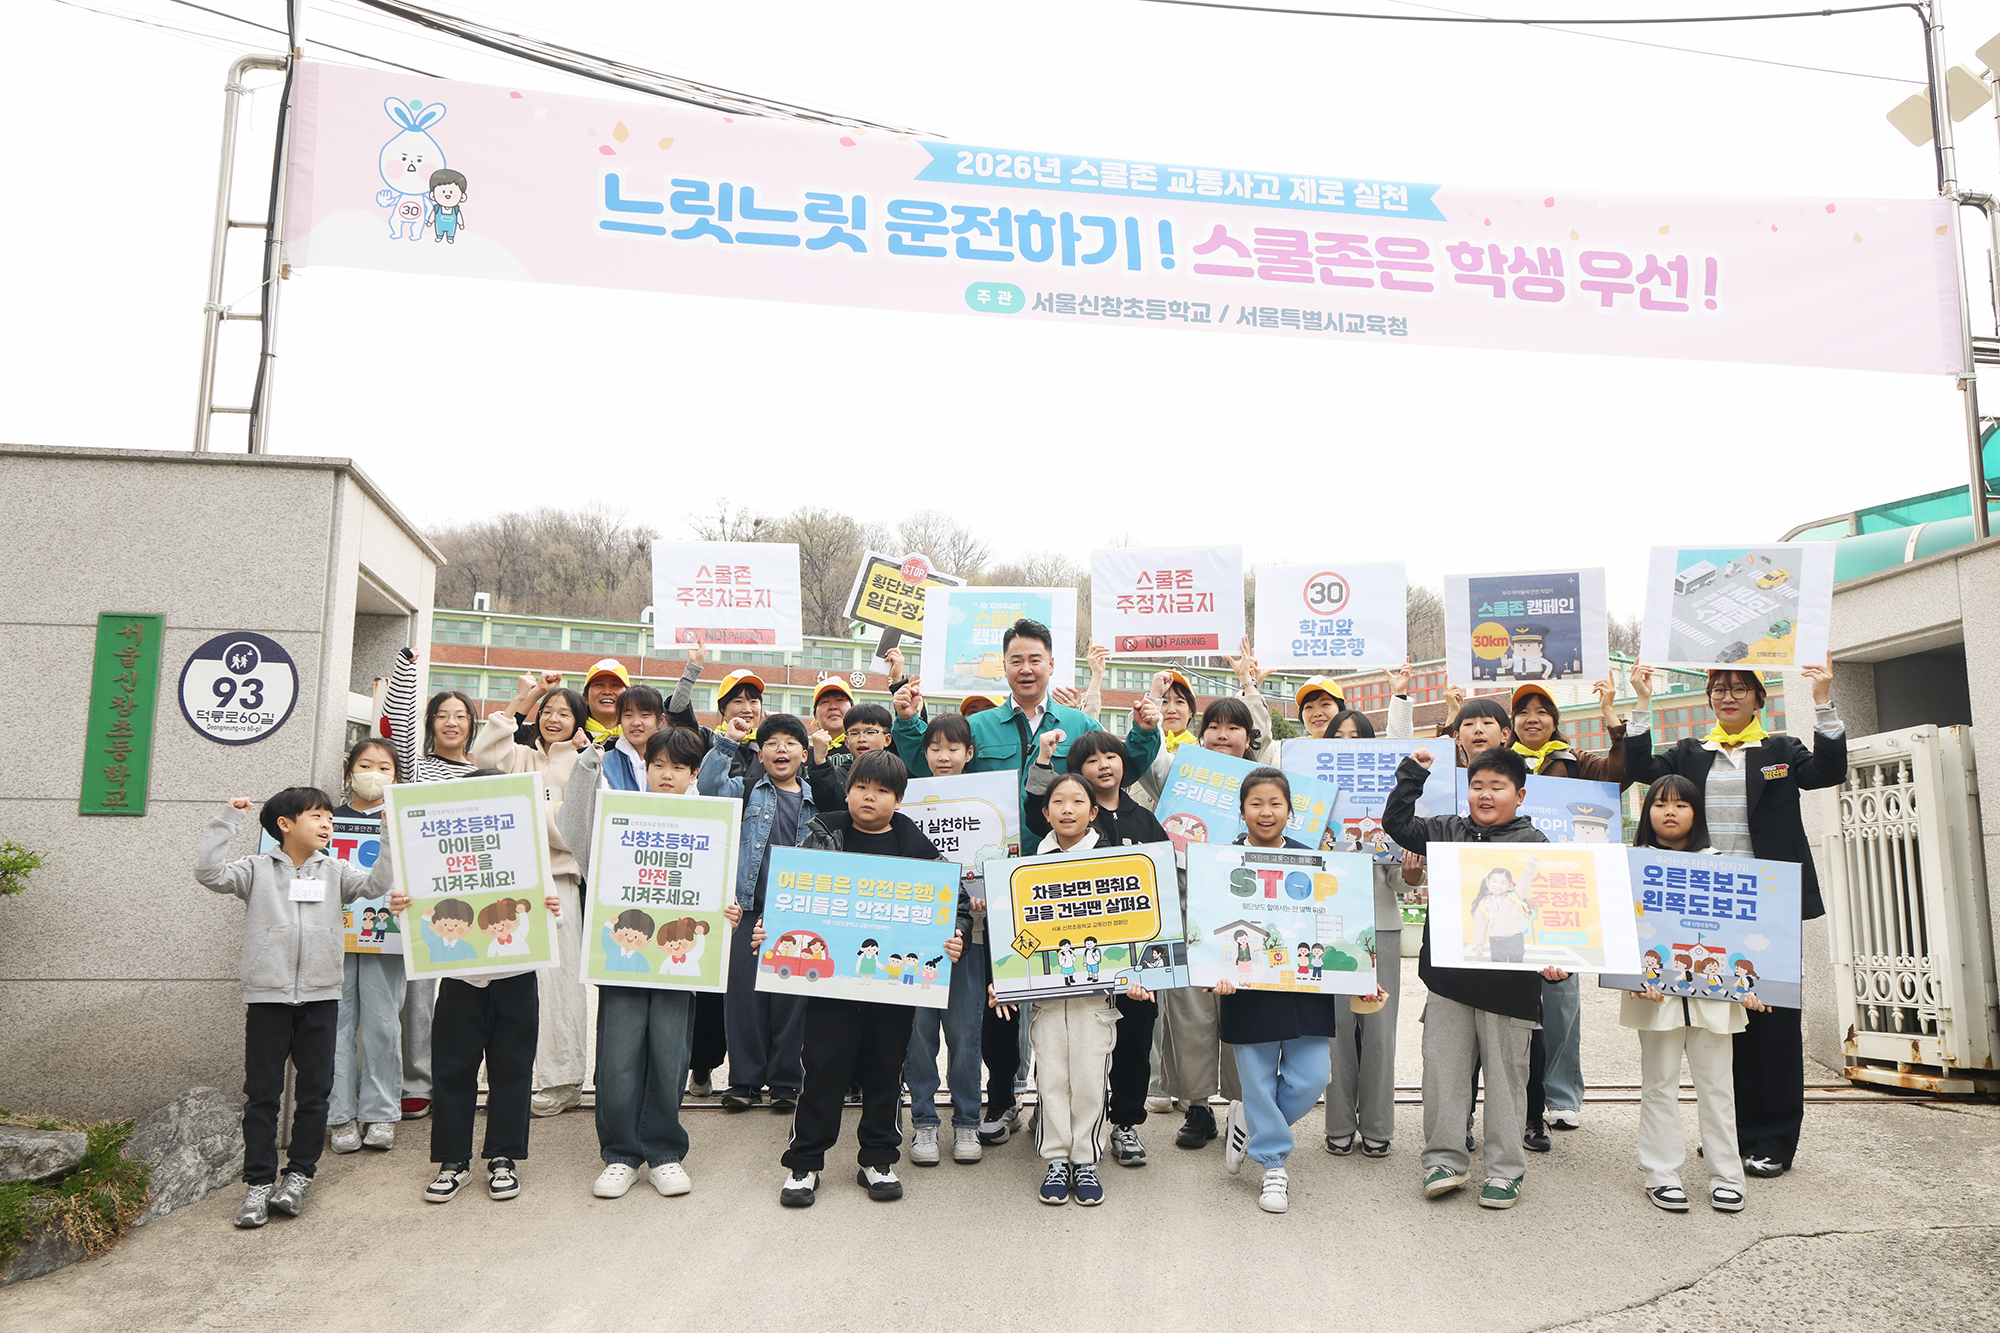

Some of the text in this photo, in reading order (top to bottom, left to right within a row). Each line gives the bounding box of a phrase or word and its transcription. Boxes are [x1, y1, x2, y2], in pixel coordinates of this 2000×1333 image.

[956, 151, 1408, 212] 2026년 스쿨존 교통사고 제로 실천
[402, 205, 419, 216] 30
[599, 173, 867, 253] 느릿느릿
[1193, 224, 1435, 293] 스쿨존은
[1445, 241, 1565, 303] 학생
[1032, 292, 1211, 323] 서울신창초등학교
[1236, 305, 1408, 337] 서울특별시교육청
[695, 565, 751, 585] 스쿨존
[904, 565, 925, 578] STOP
[1136, 569, 1193, 590] 스쿨존
[676, 588, 771, 608] 주정차금지
[1116, 592, 1214, 615] 주정차금지
[1310, 582, 1343, 604] 30
[866, 591, 924, 621] 일단정
[1478, 597, 1575, 617] 스쿨존 캠페인
[705, 629, 726, 641] NO!
[729, 632, 763, 641] PARKING
[1299, 618, 1354, 637] 학교앞
[1145, 635, 1167, 648] NO!
[1170, 637, 1205, 646] PARKING
[1291, 638, 1365, 657] 안전운행
[1473, 635, 1509, 648] 30km
[212, 677, 264, 710] 93
[101, 622, 144, 807] 서울신창초등학교
[197, 710, 274, 725] 덕릉로60길
[1326, 743, 1357, 752] 우리눈은
[1359, 743, 1381, 752] 자동차
[1171, 781, 1234, 811] 우리들은
[420, 813, 515, 838] 신창초등학교
[928, 817, 981, 834] 실천하는
[438, 834, 501, 855] 아이들의
[620, 830, 709, 851] 신창초등학교
[446, 853, 493, 874] 안전을
[634, 850, 693, 869] 아이들의
[1250, 853, 1269, 861] 어린이
[1272, 855, 1296, 863] 교통안전
[1655, 854, 1749, 873] 우리눈은 자동차 탐지기!
[432, 871, 515, 893] 지켜주세요!
[638, 868, 683, 887] 안전을
[778, 871, 935, 902] 어른들은 안전운행
[1032, 875, 1140, 901] 차를보면 멈춰요
[1230, 867, 1339, 902] STOP
[1531, 872, 1586, 889] 스쿨존
[1643, 865, 1757, 896] 오른쪽보고
[621, 886, 700, 906] 지켜주세요!
[1532, 891, 1589, 908] 주정차
[1643, 890, 1757, 921] 왼쪽도보고
[774, 893, 932, 925] 우리들은 안전보행
[1024, 895, 1151, 922] 길을 건널땐 살펴요
[1542, 911, 1581, 928] 금지
